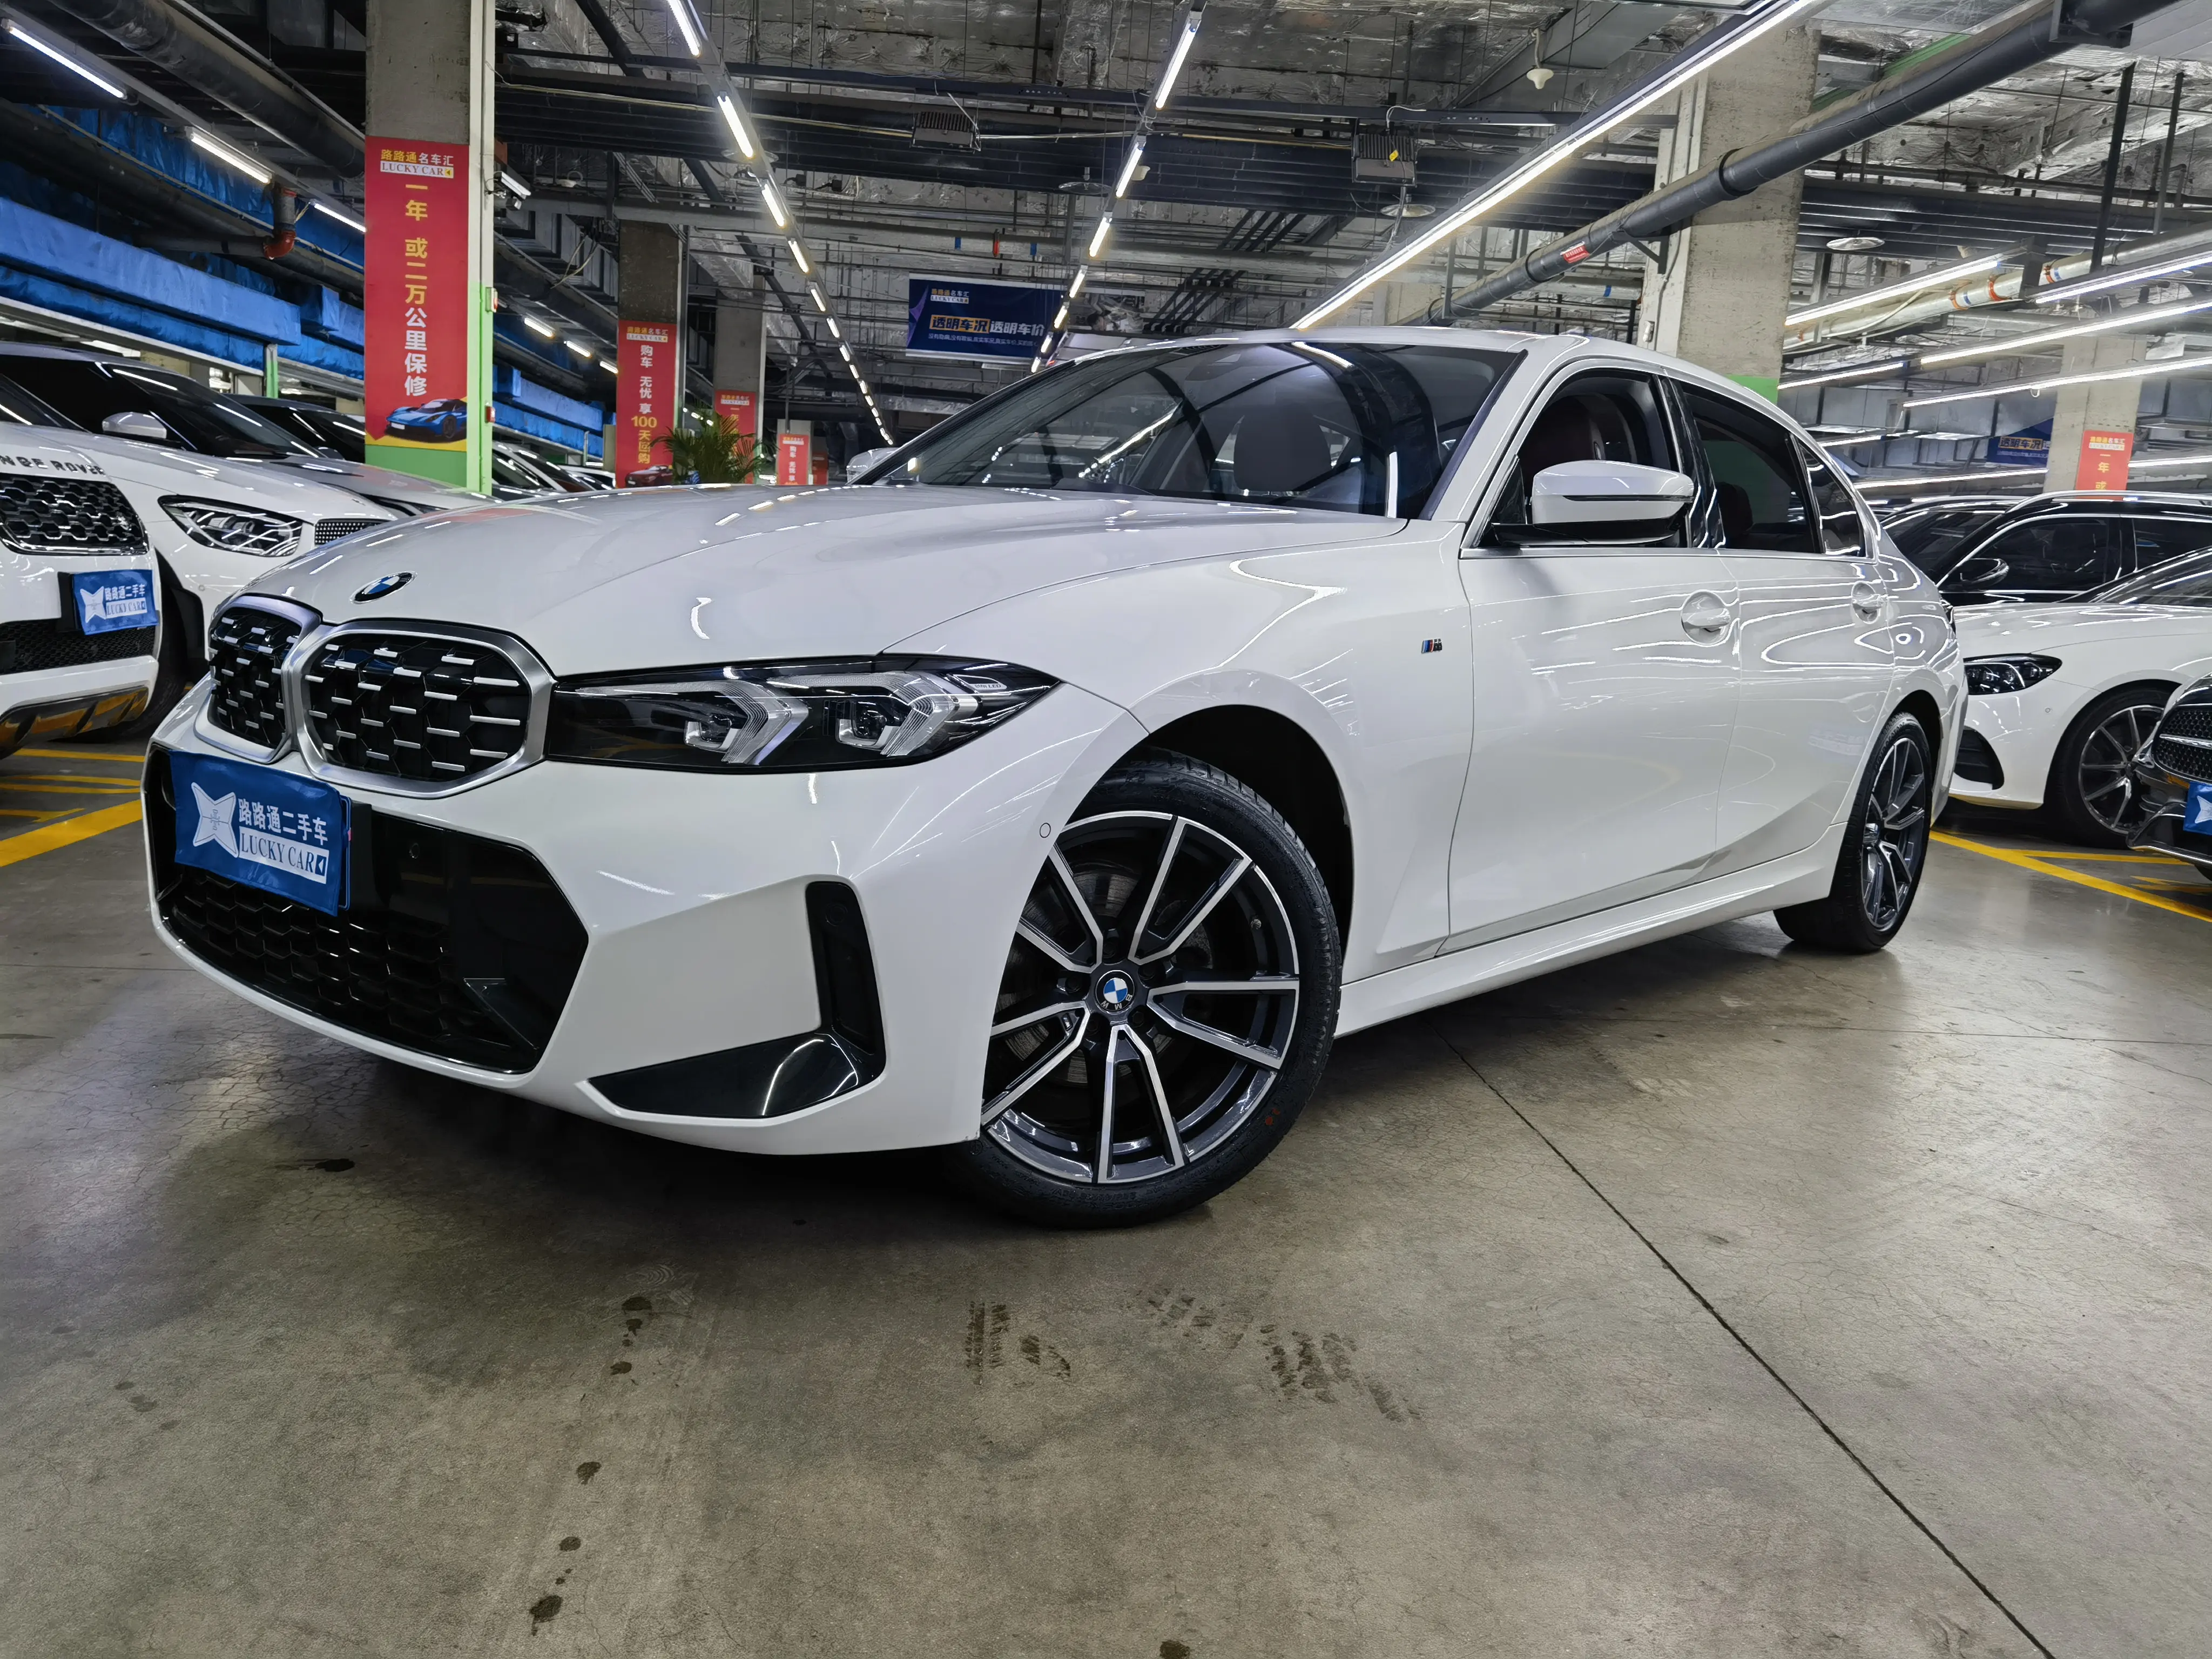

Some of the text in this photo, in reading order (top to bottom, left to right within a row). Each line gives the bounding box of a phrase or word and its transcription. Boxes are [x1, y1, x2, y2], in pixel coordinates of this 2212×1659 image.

[381, 149, 454, 166] 路路通名车汇
[382, 163, 444, 176] LUCKY CAR
[50, 460, 106, 476] ROVER
[107, 601, 141, 615] LUCKY CAR
[238, 798, 328, 846] 路路通二手车
[241, 833, 314, 873] LUCKY CAR
